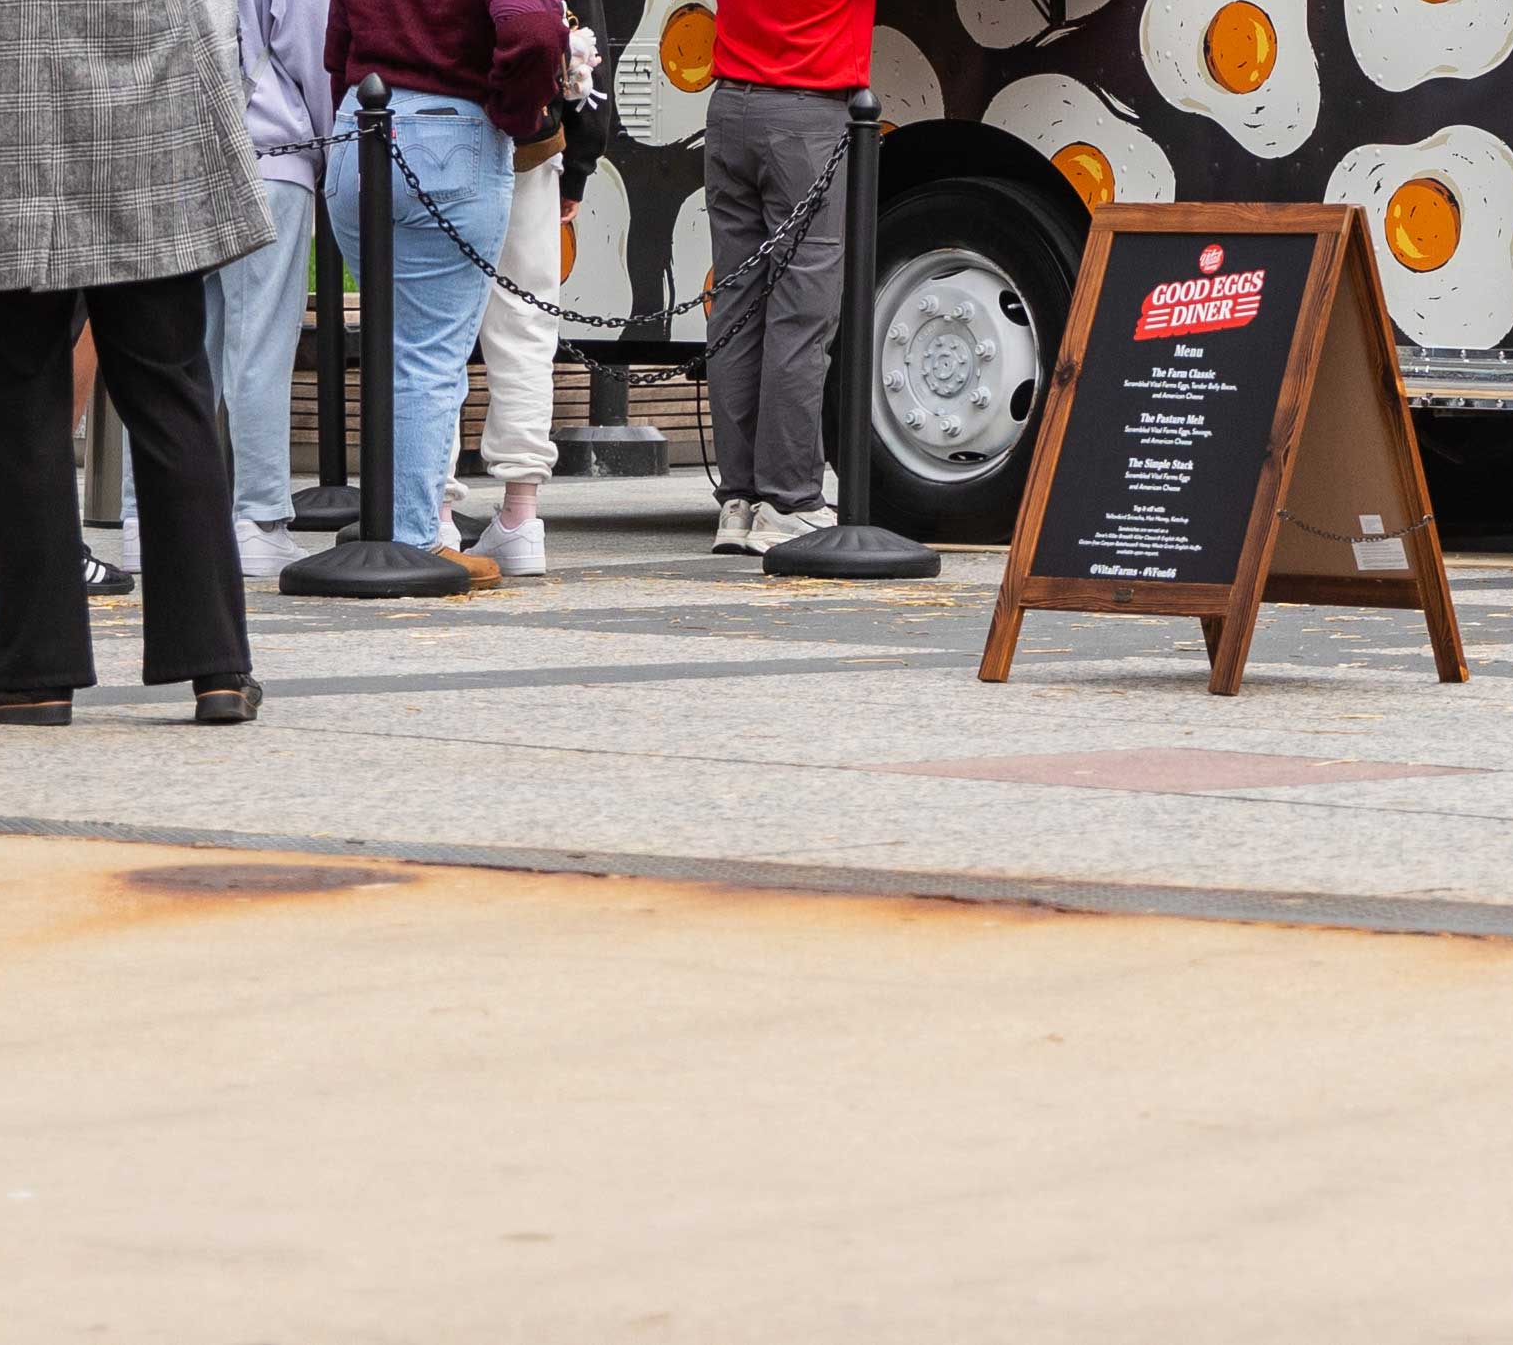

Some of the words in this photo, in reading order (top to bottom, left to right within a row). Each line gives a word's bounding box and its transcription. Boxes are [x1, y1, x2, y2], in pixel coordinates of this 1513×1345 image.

[1152, 279, 1210, 305] GOOD
[1211, 270, 1265, 297] EGGS
[1170, 300, 1233, 327] DINER
[1174, 344, 1203, 357] Menu
[1152, 367, 1166, 377] The
[1167, 368, 1187, 378] Farm
[1189, 369, 1216, 379] Classic
[1141, 412, 1155, 423] The
[1156, 413, 1185, 424] Pasture
[1186, 414, 1205, 425] Melt
[1129, 458, 1143, 468] The
[1144, 458, 1171, 470] Simple
[1171, 460, 1193, 470] Stack
[1090, 564, 1138, 576] @VitalFarms
